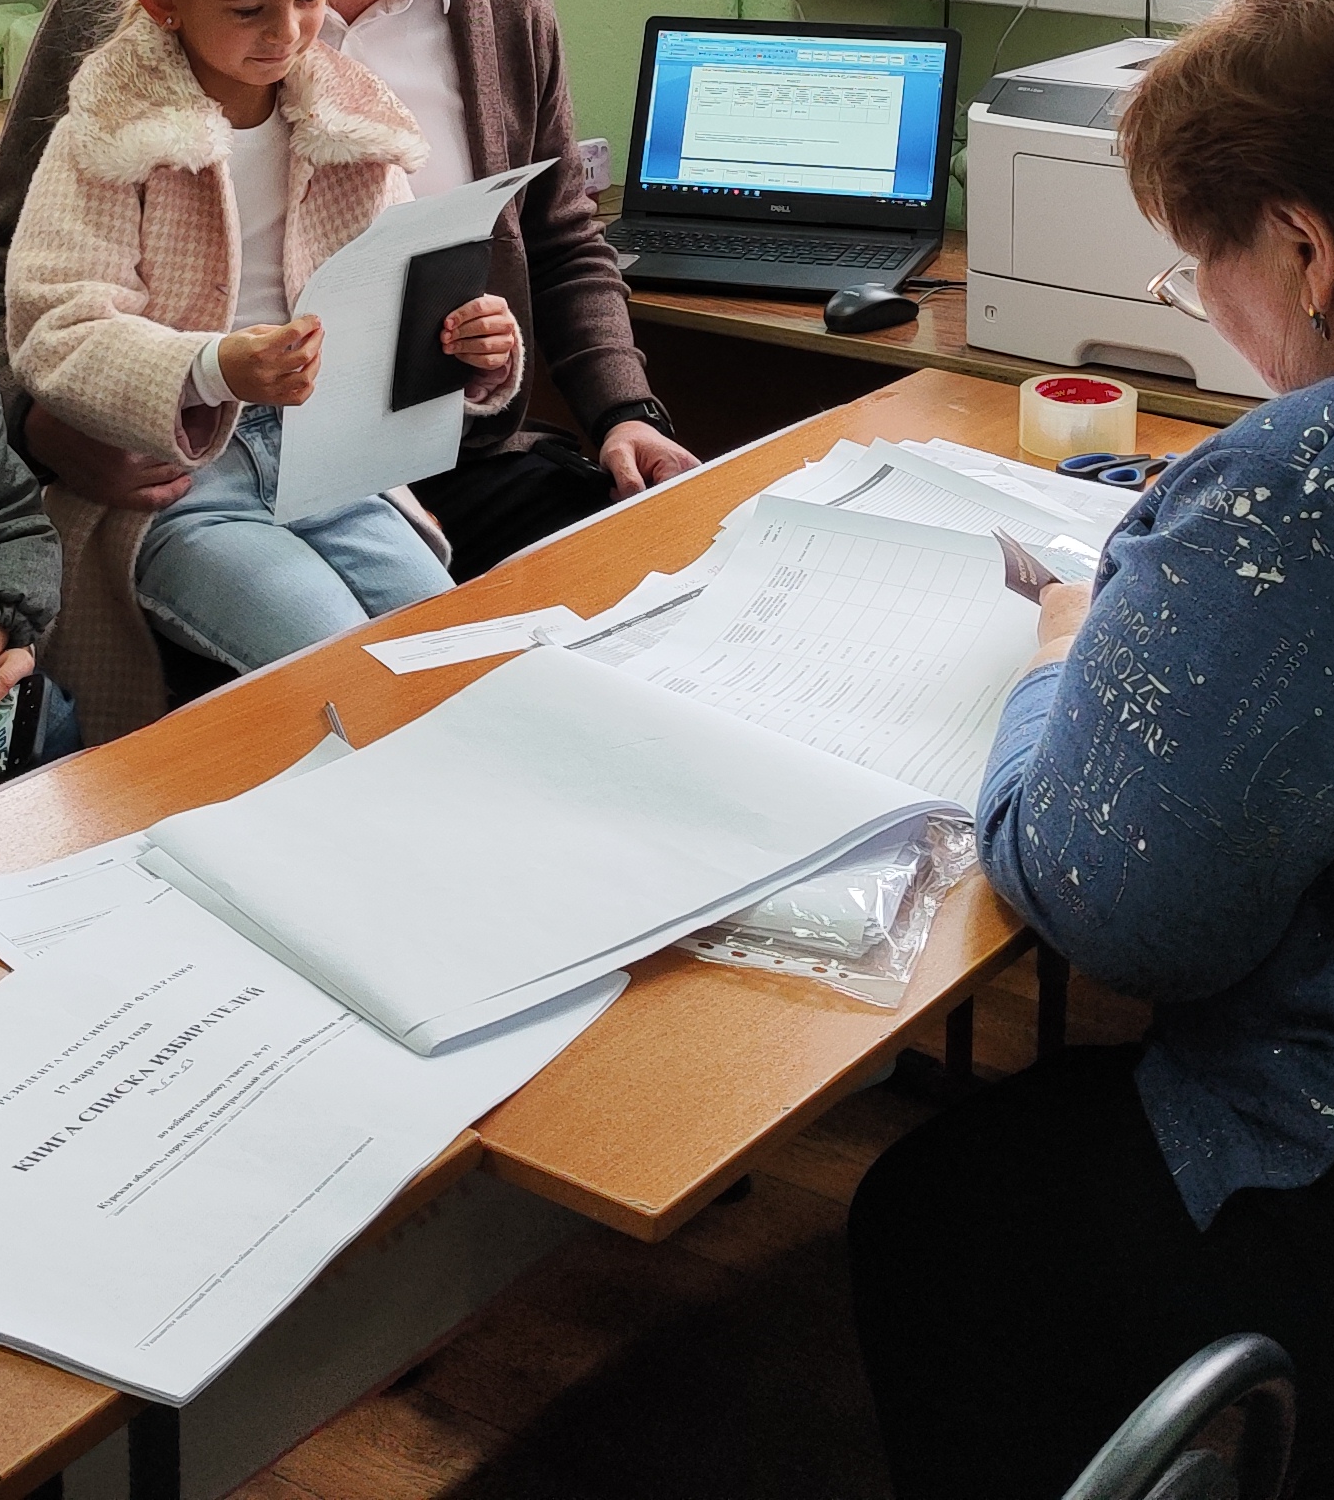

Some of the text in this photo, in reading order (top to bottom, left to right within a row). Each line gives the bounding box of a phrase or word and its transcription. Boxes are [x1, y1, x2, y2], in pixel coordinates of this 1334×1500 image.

[54, 1022, 153, 1095] 17 марта 2024 года
[62, 1001, 135, 1057] РОССИЙСКОЙ
[11, 986, 266, 1172] КНИГА СПИСКА ИЗБИРАТЕЛЕЙ
